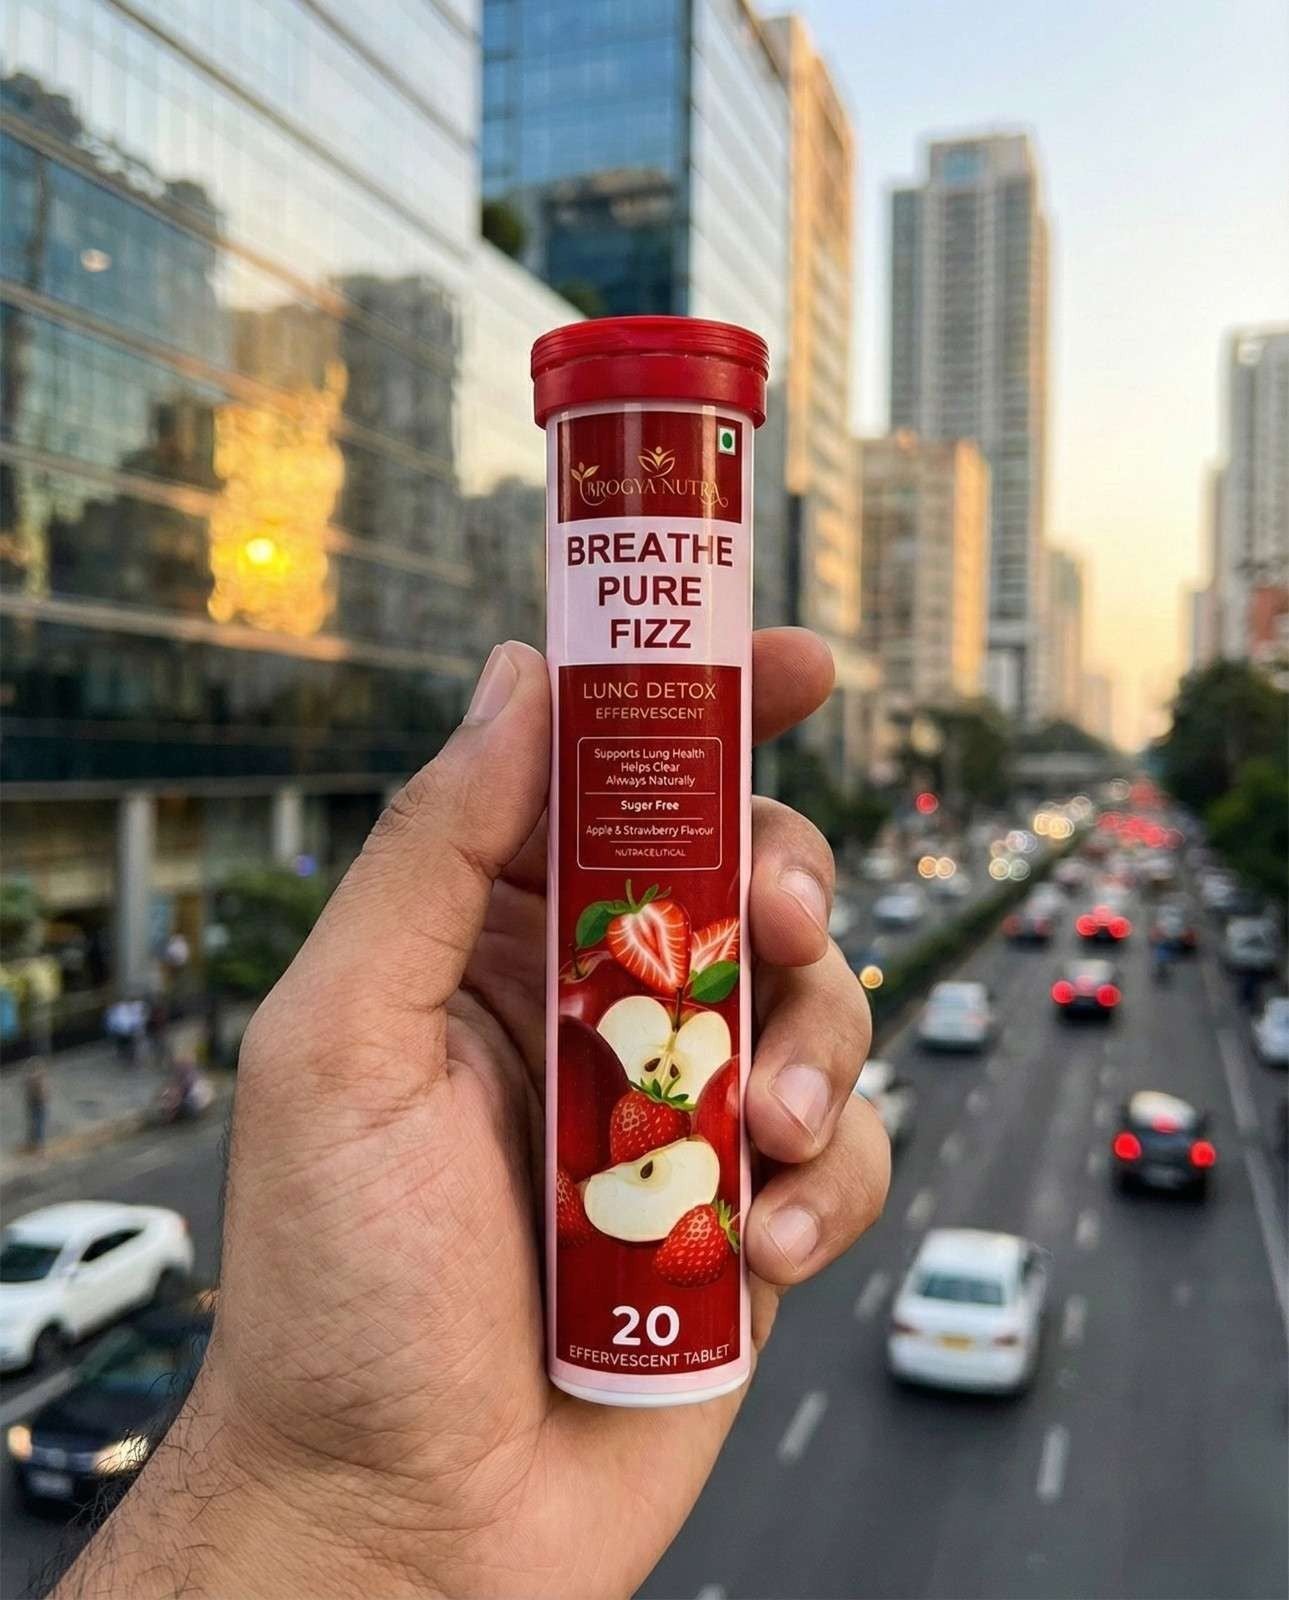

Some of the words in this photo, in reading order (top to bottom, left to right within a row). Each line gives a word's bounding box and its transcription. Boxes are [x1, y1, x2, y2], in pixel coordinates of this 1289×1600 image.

[661, 479, 728, 508] NUTRA
[567, 532, 733, 567] BREATHE
[598, 575, 702, 607] PURE
[610, 618, 691, 649] FIZZ
[583, 682, 639, 700] LUNG
[646, 682, 717, 700] DETOX
[595, 707, 705, 720] EFFERVESCENT
[594, 748, 641, 760] Supports
[642, 748, 670, 761] Lung
[672, 747, 705, 759] Health
[620, 761, 651, 774] Helps
[652, 761, 680, 773] Clear
[648, 775, 696, 788] Naturally
[655, 800, 680, 811] Free
[585, 825, 613, 837] Apple
[614, 825, 622, 835] &
[623, 825, 679, 838] Strawberry
[680, 825, 714, 836] Flavour
[615, 848, 686, 857] NUTRACEUTICAL
[612, 1305, 680, 1347] 20
[569, 1345, 680, 1368] EFFERVESCENT
[684, 1343, 730, 1365] TABLET
